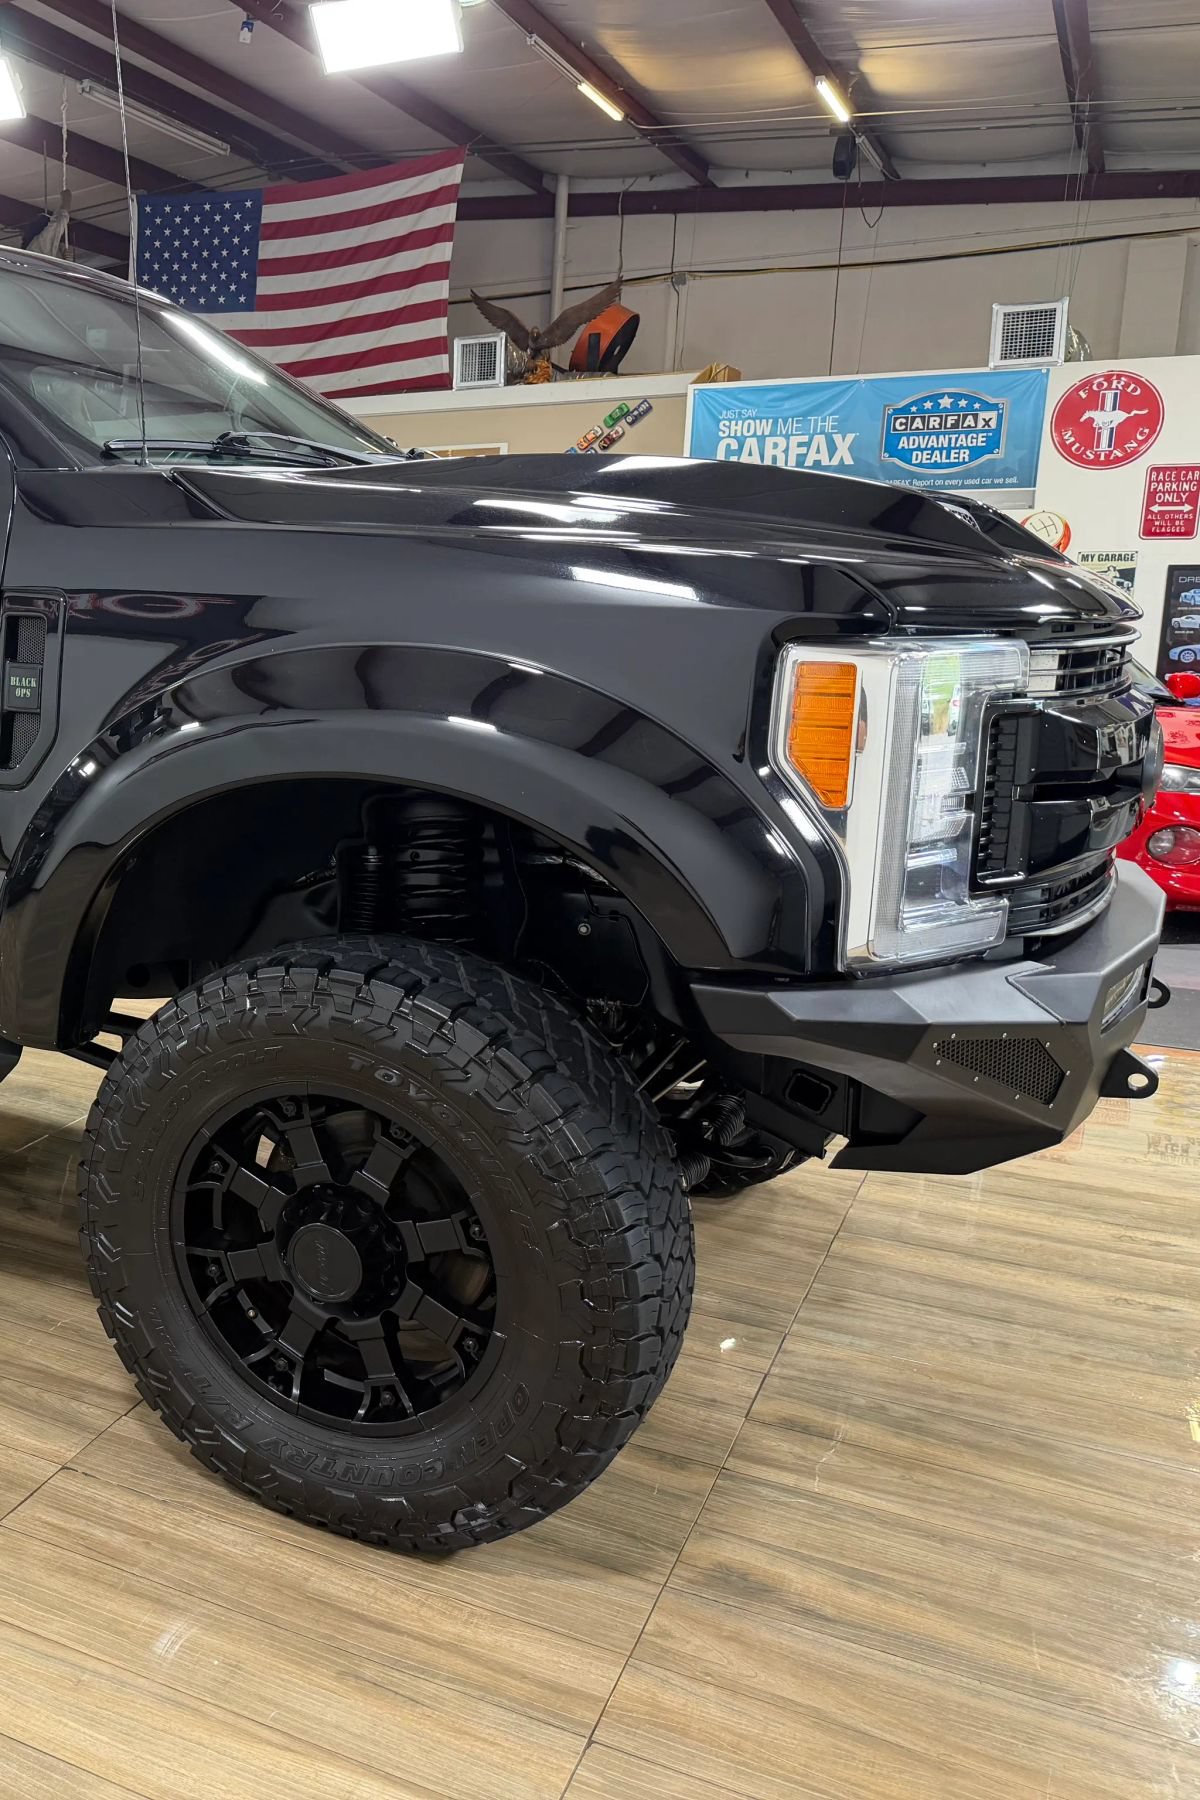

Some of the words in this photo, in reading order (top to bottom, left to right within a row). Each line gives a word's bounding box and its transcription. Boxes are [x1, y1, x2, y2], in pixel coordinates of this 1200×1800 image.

[1078, 376, 1141, 399] FORD
[719, 410, 738, 419] JUST
[741, 408, 758, 418] SAY
[718, 418, 773, 437] SHOW
[777, 417, 803, 435] ME
[808, 415, 839, 434] THE
[894, 414, 994, 431] CARFAX
[898, 433, 987, 449] ADVANTAGE
[1062, 427, 1150, 461] MUSTANG
[716, 433, 856, 467] CARFAX
[911, 450, 970, 464] DEALER
[912, 479, 933, 487] Report
[1151, 471, 1177, 481] RACE
[1180, 471, 1200, 481] CAR
[1150, 481, 1198, 492] PARKING
[1156, 492, 1189, 503] ONLY
[1081, 553, 1096, 562] MY
[1097, 553, 1136, 562] GARAGE
[10, 676, 37, 688] BLACK
[348, 1052, 462, 1128] TOYO
[258, 1436, 446, 1486] COUNTRY
